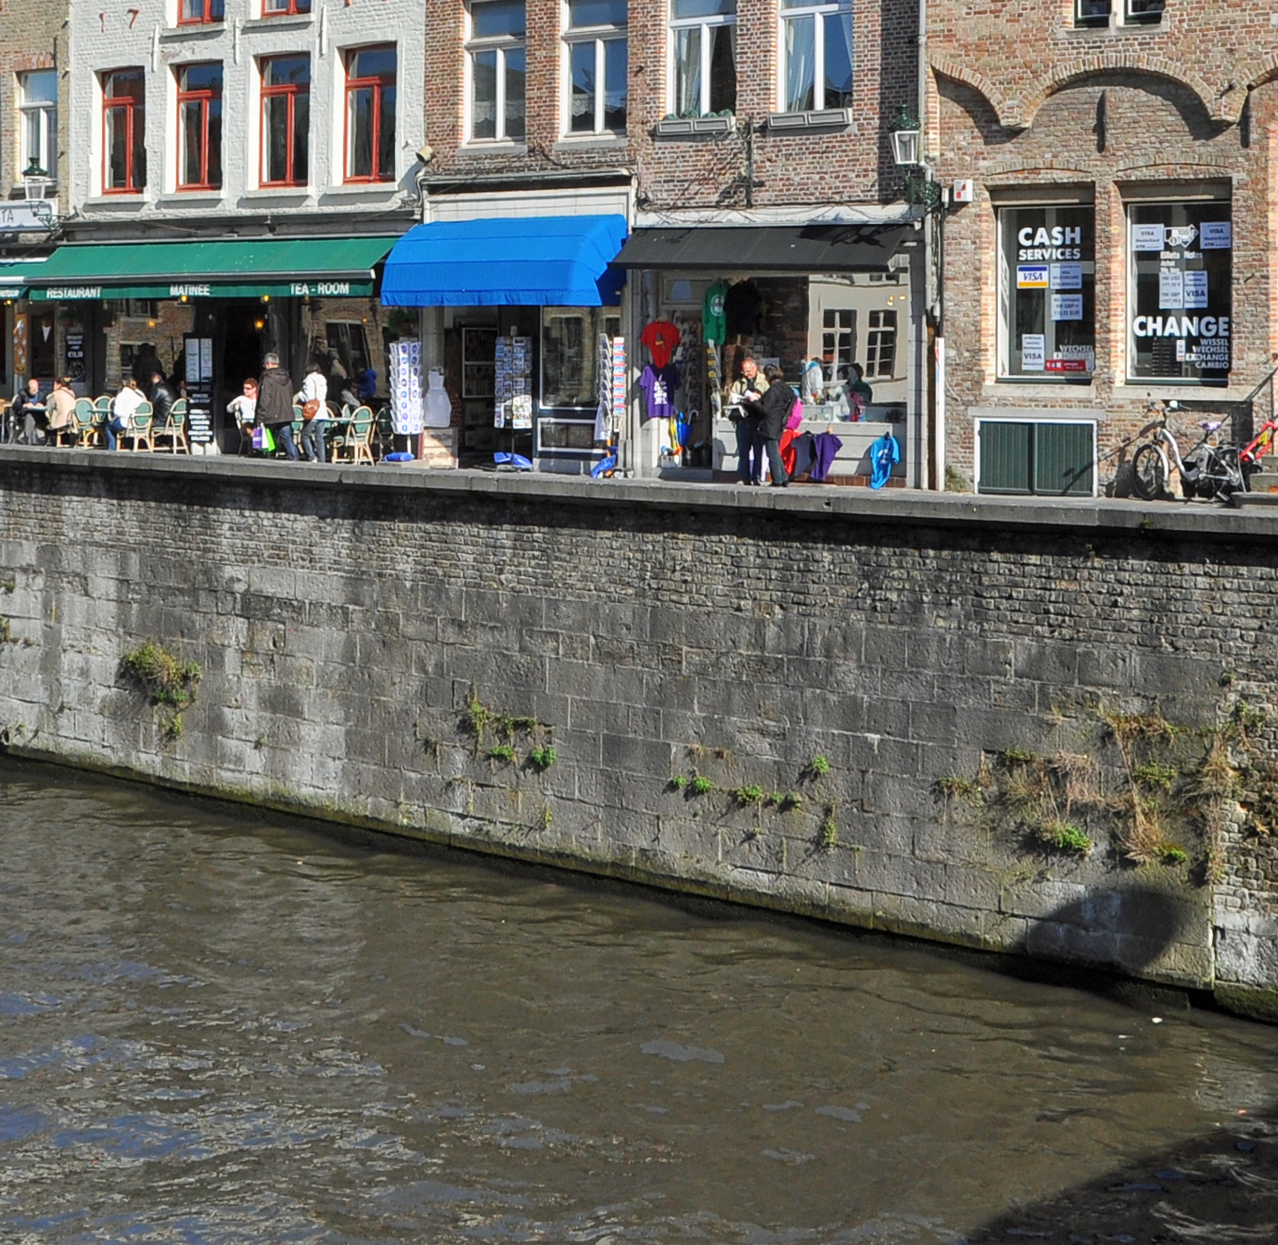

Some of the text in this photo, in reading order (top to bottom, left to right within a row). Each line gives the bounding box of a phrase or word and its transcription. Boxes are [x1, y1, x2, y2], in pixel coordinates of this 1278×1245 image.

[127, 8, 139, 29] 7
[1018, 226, 1081, 246] CASH
[1018, 248, 1081, 260] SERVICES
[1023, 272, 1043, 281] VISA
[46, 286, 102, 299] RESTAURANT
[170, 284, 210, 296] MATINEE
[290, 283, 309, 295] TEA
[317, 282, 349, 294] ROOM
[1133, 316, 1229, 336] CHANGE
[1059, 344, 1093, 352] WECHSEL
[1200, 338, 1229, 346] WISSEL
[1192, 345, 1229, 353] WECHSEL
[1186, 353, 1229, 361] EXCHANGE
